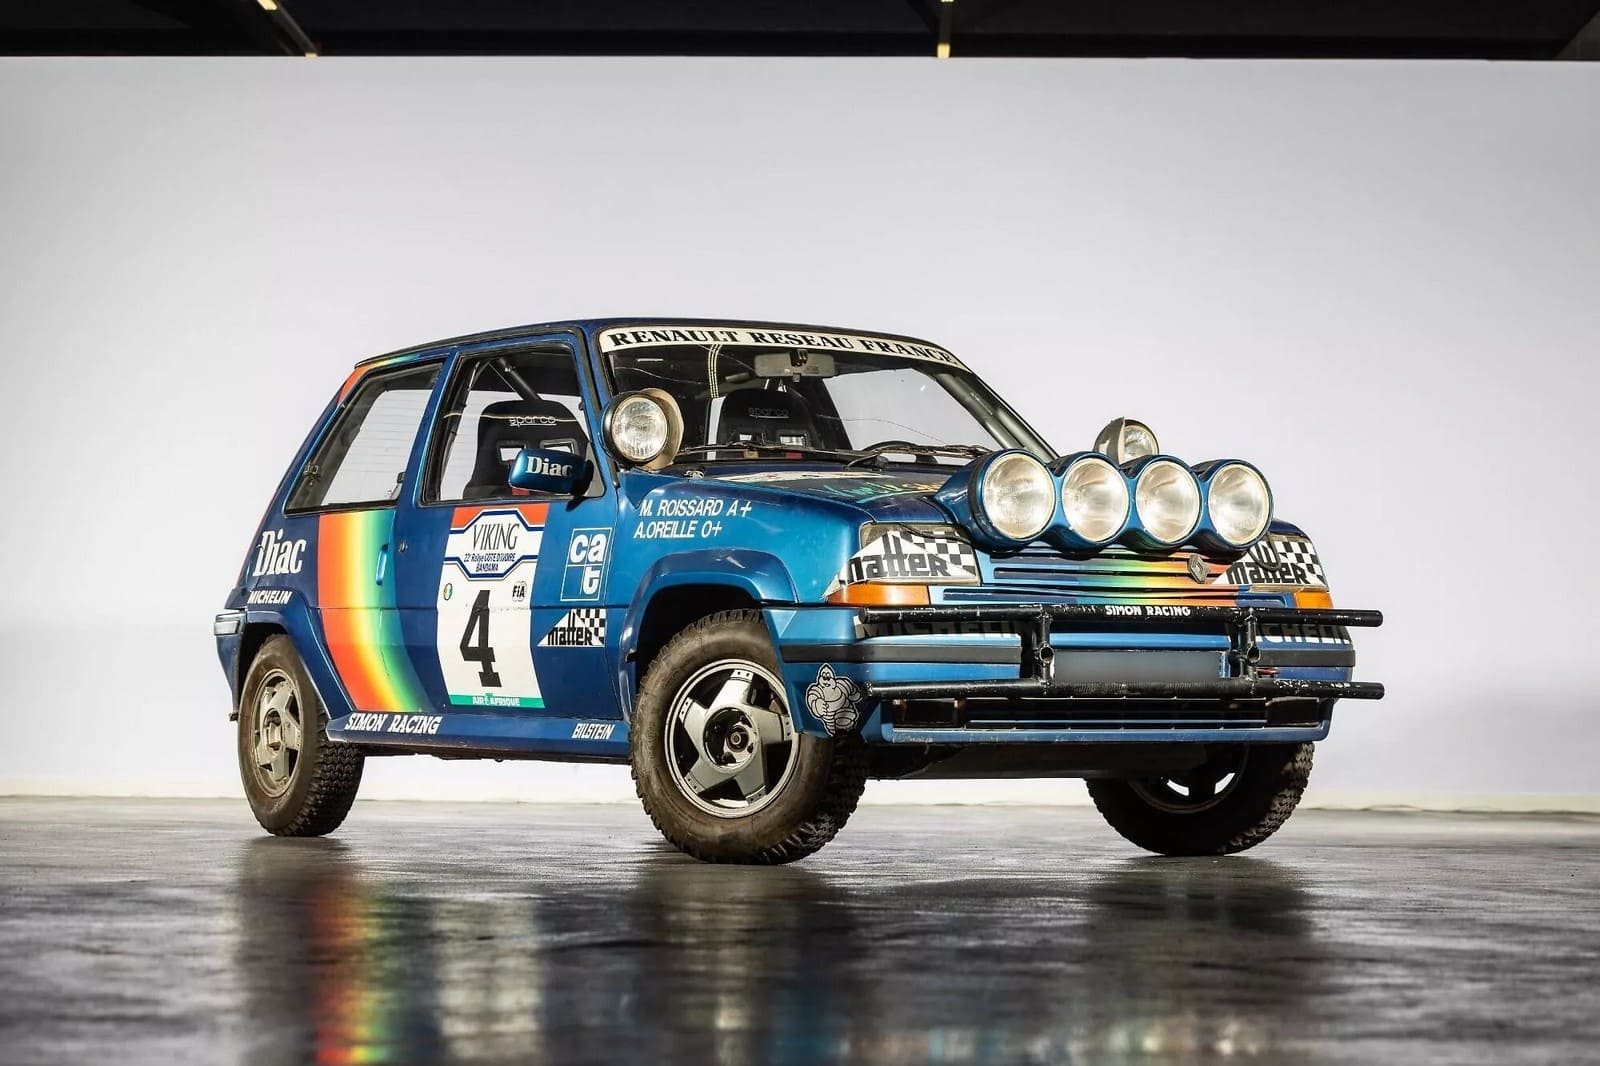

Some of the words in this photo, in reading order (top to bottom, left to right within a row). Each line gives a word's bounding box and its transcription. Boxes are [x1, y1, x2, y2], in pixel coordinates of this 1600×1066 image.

[607, 329, 740, 347] RENAULT
[746, 331, 855, 349] RESEAU
[856, 339, 959, 365] FRANCE
[509, 415, 556, 428] sparco
[525, 456, 573, 477] Diac
[640, 499, 653, 517] M.
[657, 499, 724, 517] ROISSARD
[473, 523, 519, 551] VIKING
[633, 520, 698, 539] A.OREILLE
[252, 528, 307, 577] Diac
[247, 590, 293, 605] MICHELIN
[1105, 605, 1142, 616] SIMON
[1145, 605, 1191, 617] RACING
[460, 590, 502, 688] 4
[344, 712, 388, 731] SIMON
[387, 714, 443, 735] RACING
[571, 722, 615, 740] BILSTEIN
